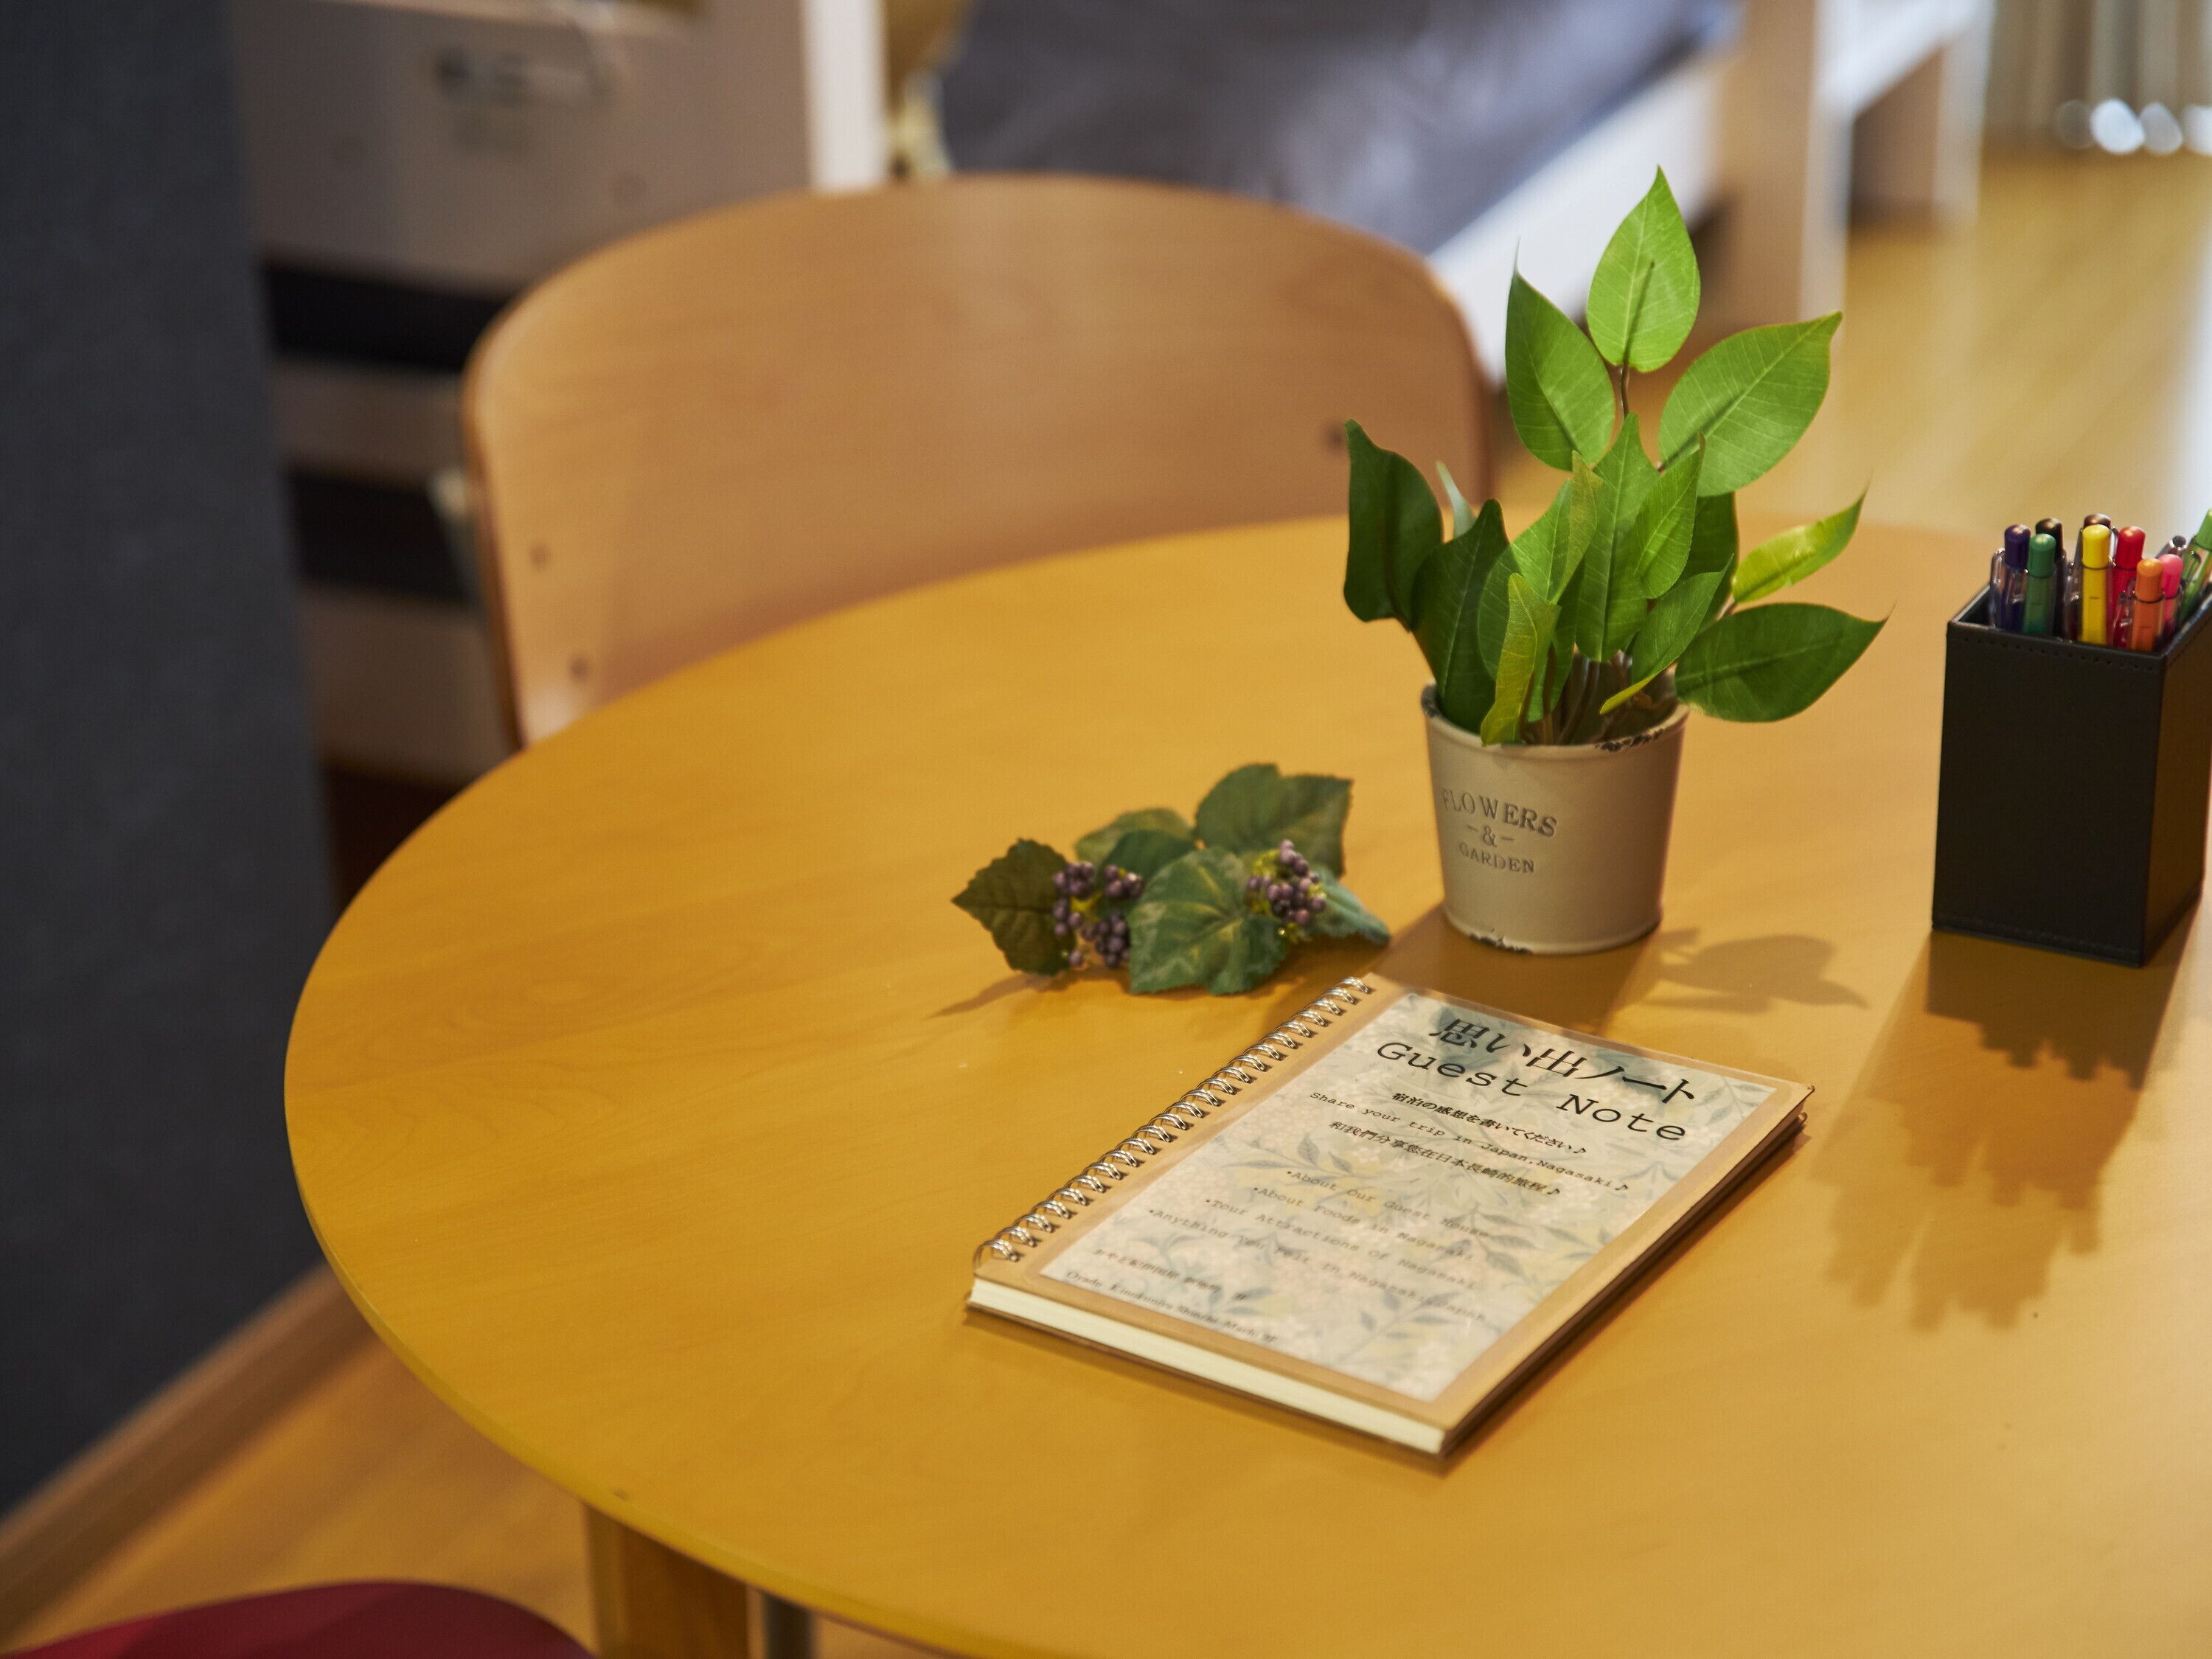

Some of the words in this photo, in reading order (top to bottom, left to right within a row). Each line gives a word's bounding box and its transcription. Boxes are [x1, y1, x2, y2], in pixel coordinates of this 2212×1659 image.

[1441, 787, 1558, 838] FLOWERS
[1458, 841, 1535, 874] GARDEN
[1429, 1018, 1695, 1104] 思い出ノート
[1377, 1042, 1528, 1097] Guest
[1555, 1093, 1686, 1141] Note
[1310, 1091, 1355, 1110] Share
[1361, 1107, 1402, 1123] your
[1408, 1121, 1446, 1137] trip
[1453, 1135, 1472, 1144] in
[1211, 1200, 1249, 1216] Tour
[1257, 1188, 1305, 1208] About
[1346, 1189, 1377, 1203] Our
